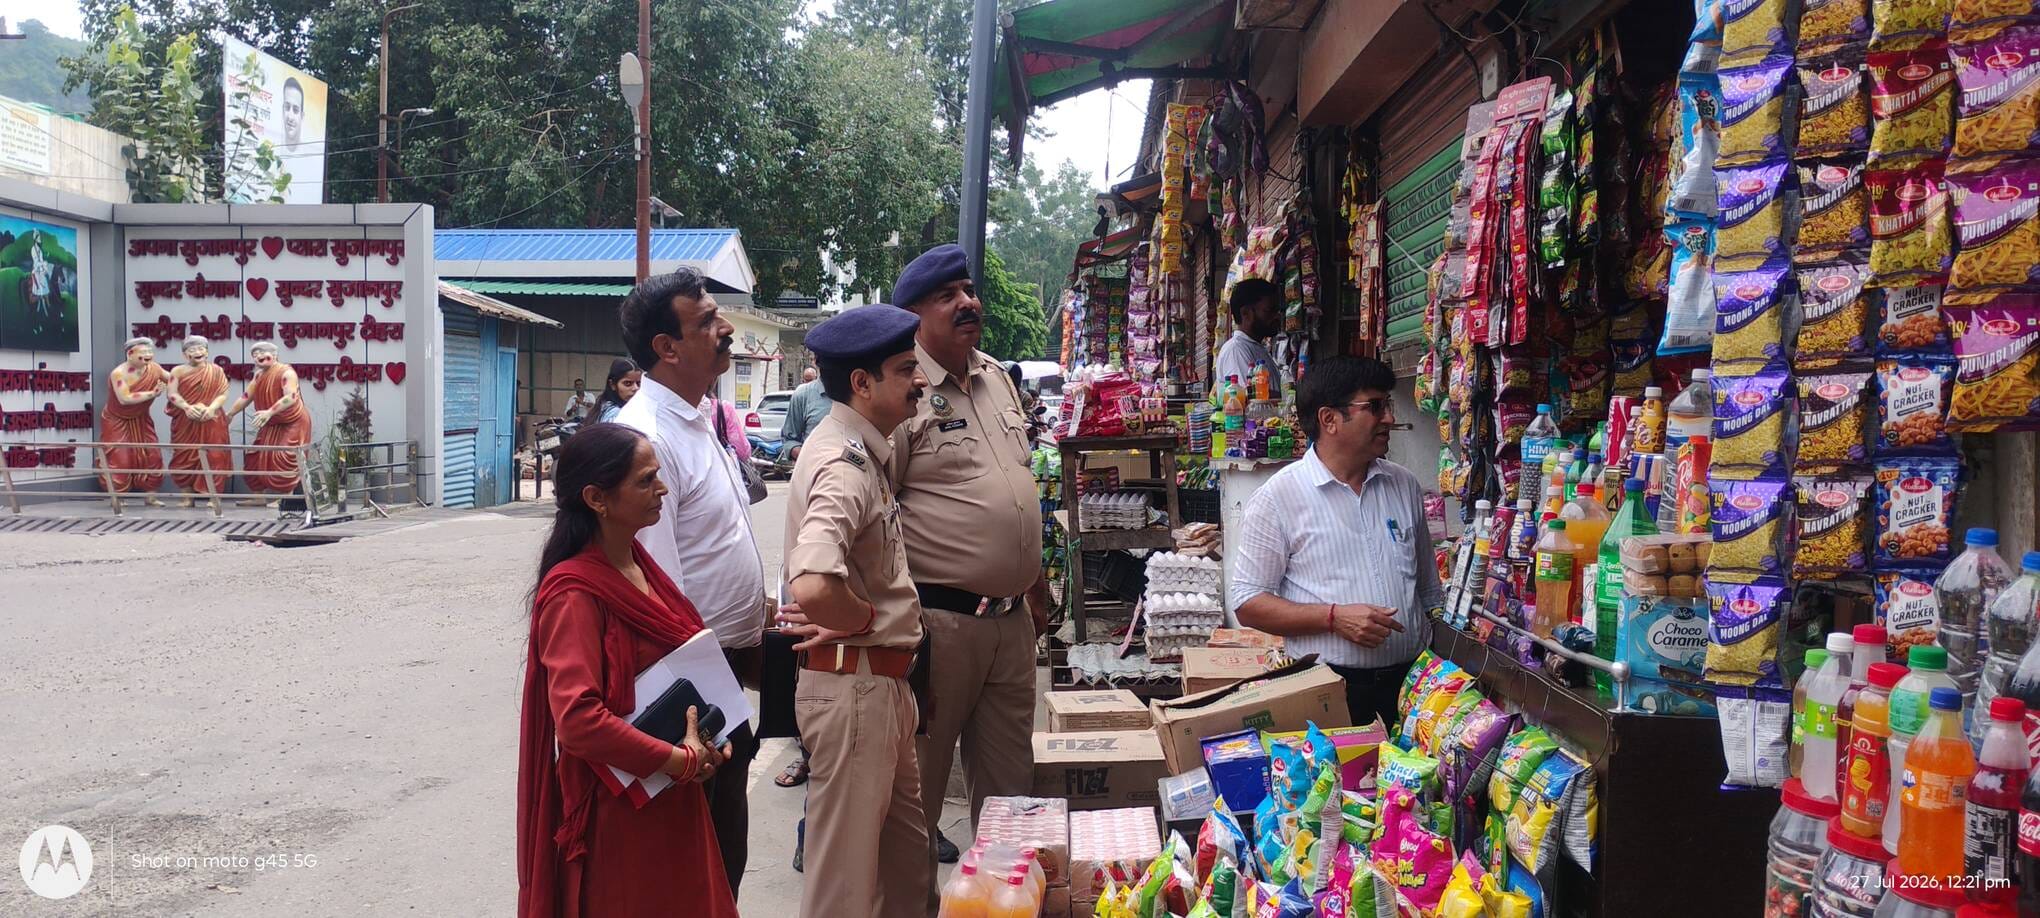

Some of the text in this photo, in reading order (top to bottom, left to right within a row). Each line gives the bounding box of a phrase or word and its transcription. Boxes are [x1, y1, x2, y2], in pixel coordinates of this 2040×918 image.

[1725, 87, 1771, 121] MOONG DAL
[1964, 79, 2008, 107] PUNJABI
[1725, 190, 1772, 222] MOONG DAL
[1806, 175, 1860, 211] NAVRATTAN
[1878, 210, 1913, 233] KHATTA
[1961, 197, 2040, 241] PUNJABI TADKA
[180, 239, 258, 266] सुजानपुर
[135, 281, 183, 308] सुन्दर
[275, 280, 323, 308] सुन्दर
[326, 280, 403, 308] सुजानपुर
[1805, 285, 1861, 319] NAVRATTAN
[1893, 293, 1935, 312] CRACKER
[1905, 287, 1922, 297] NUT
[1724, 295, 1770, 327] MOONG DAL
[278, 322, 356, 349] सुजानपुर
[1961, 331, 2039, 374] PUNJABI TADKA
[1893, 390, 1935, 409] CRACKER
[1905, 384, 1922, 394] NUT
[1723, 402, 1771, 432] MOONG DAL
[1804, 394, 1860, 427] NAVRATTAN
[1895, 502, 1936, 521] CRACKER
[1907, 496, 1924, 508] NUT
[1721, 508, 1769, 536] MOONG DAL
[1804, 501, 1859, 534] NAVRATTAN
[1892, 606, 1935, 623] CRACKER
[1905, 600, 1923, 610] NUT
[1653, 631, 1708, 648] Carame
[1665, 622, 1702, 636] Choco
[1720, 613, 1768, 640] MOONG DAL
[1244, 713, 1270, 727] KITTY
[1391, 761, 1421, 778] Uncle
